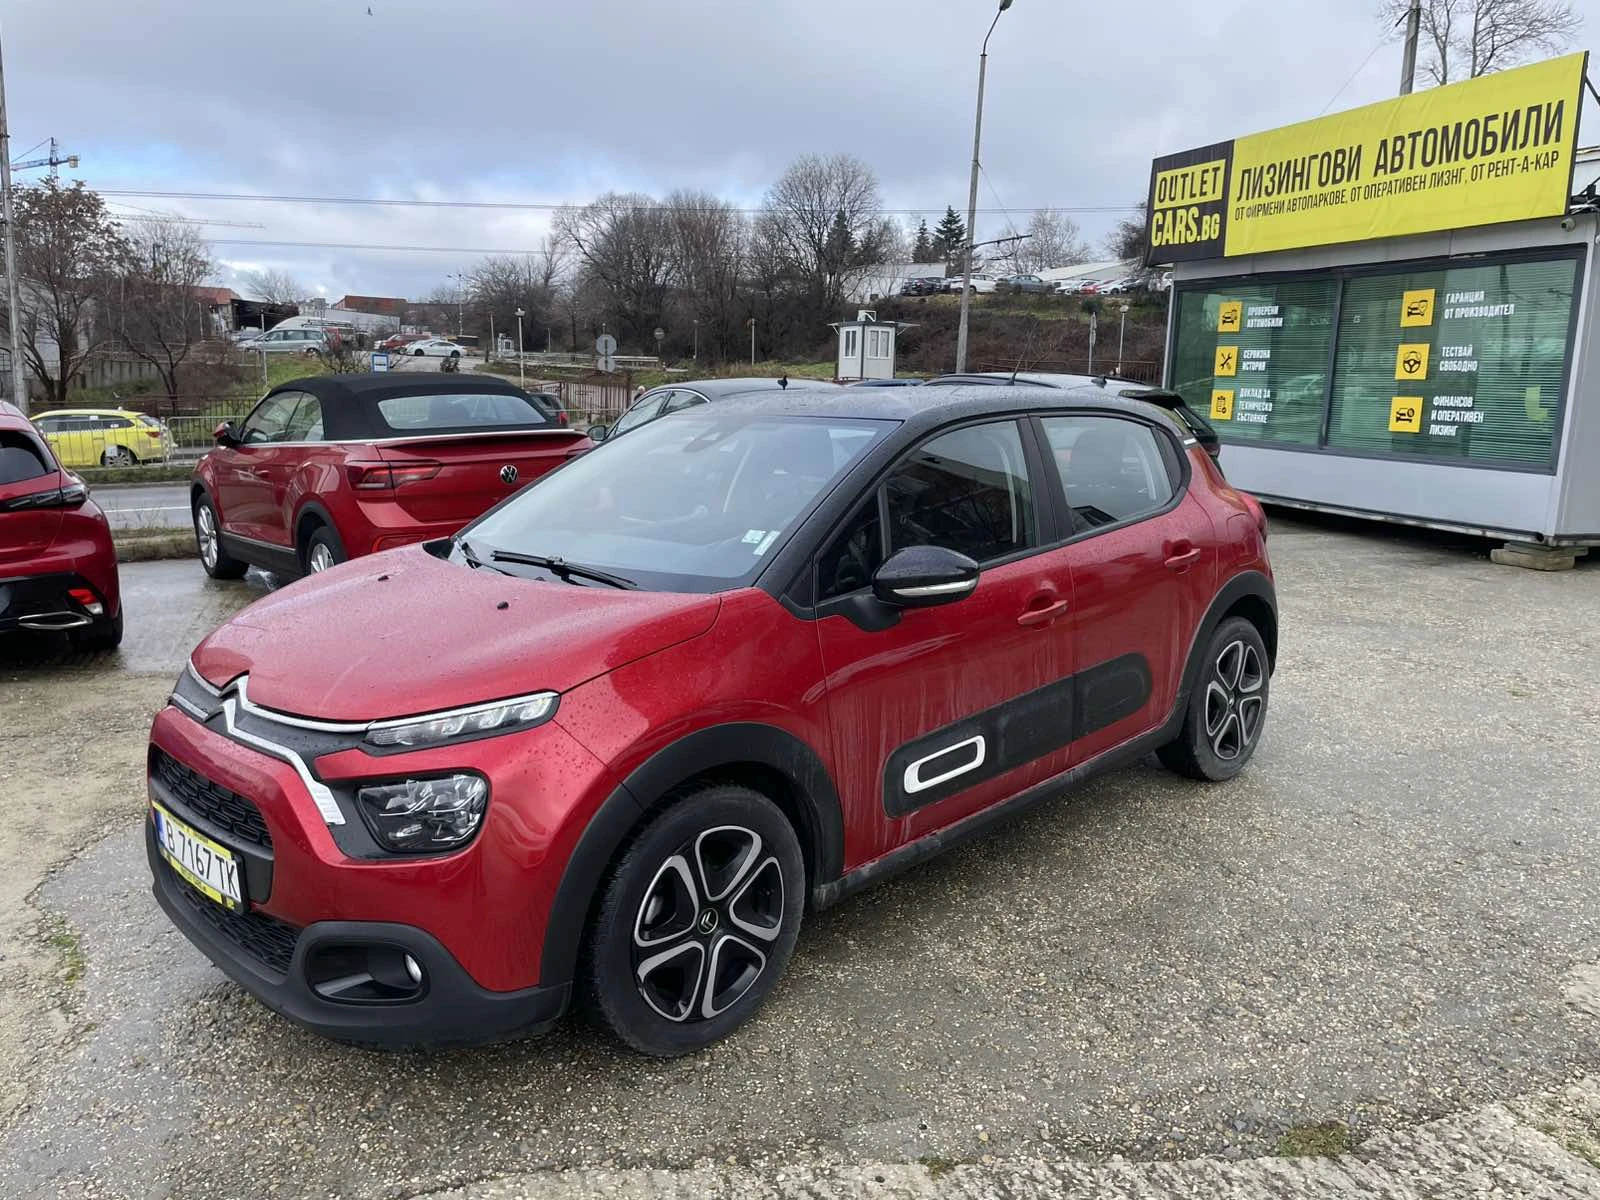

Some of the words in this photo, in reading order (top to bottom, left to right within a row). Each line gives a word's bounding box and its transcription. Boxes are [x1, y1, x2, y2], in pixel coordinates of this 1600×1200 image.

[1237, 144, 1362, 202] ЛИЗИНГОВИ
[1373, 100, 1565, 177] АВТОМОБИЛИ
[1158, 166, 1221, 203] OUTLET
[1235, 206, 1245, 221] ОТ
[1246, 203, 1285, 218] ФИРМЕНИ
[1286, 189, 1348, 213] АВТОПАРКОВЕ,
[1350, 186, 1362, 202] ОТ
[1363, 174, 1427, 200] ОПЕРАТИВЕН
[1471, 163, 1486, 182] ОТ
[1487, 150, 1559, 178] РЕНТ-А-КАР
[1151, 206, 1220, 247] CARS.BG
[1445, 290, 1484, 304] ГАРАНЦИЯ
[1444, 308, 1454, 319] ОТ
[1454, 303, 1515, 319] ПРОИЗВОДИТЕЛ
[1442, 344, 1473, 357] ТЕСТВАЙ
[1439, 360, 1478, 372] СВОБОДНО
[1432, 395, 1473, 408] ФИНАНСОВ
[1431, 409, 1437, 421] И
[1437, 410, 1485, 423] ОПЕРАТИВЕН
[1429, 424, 1459, 436] ЛИЗИНГ
[166, 820, 175, 853] B
[178, 830, 212, 880] 7167
[215, 854, 239, 898] TK
